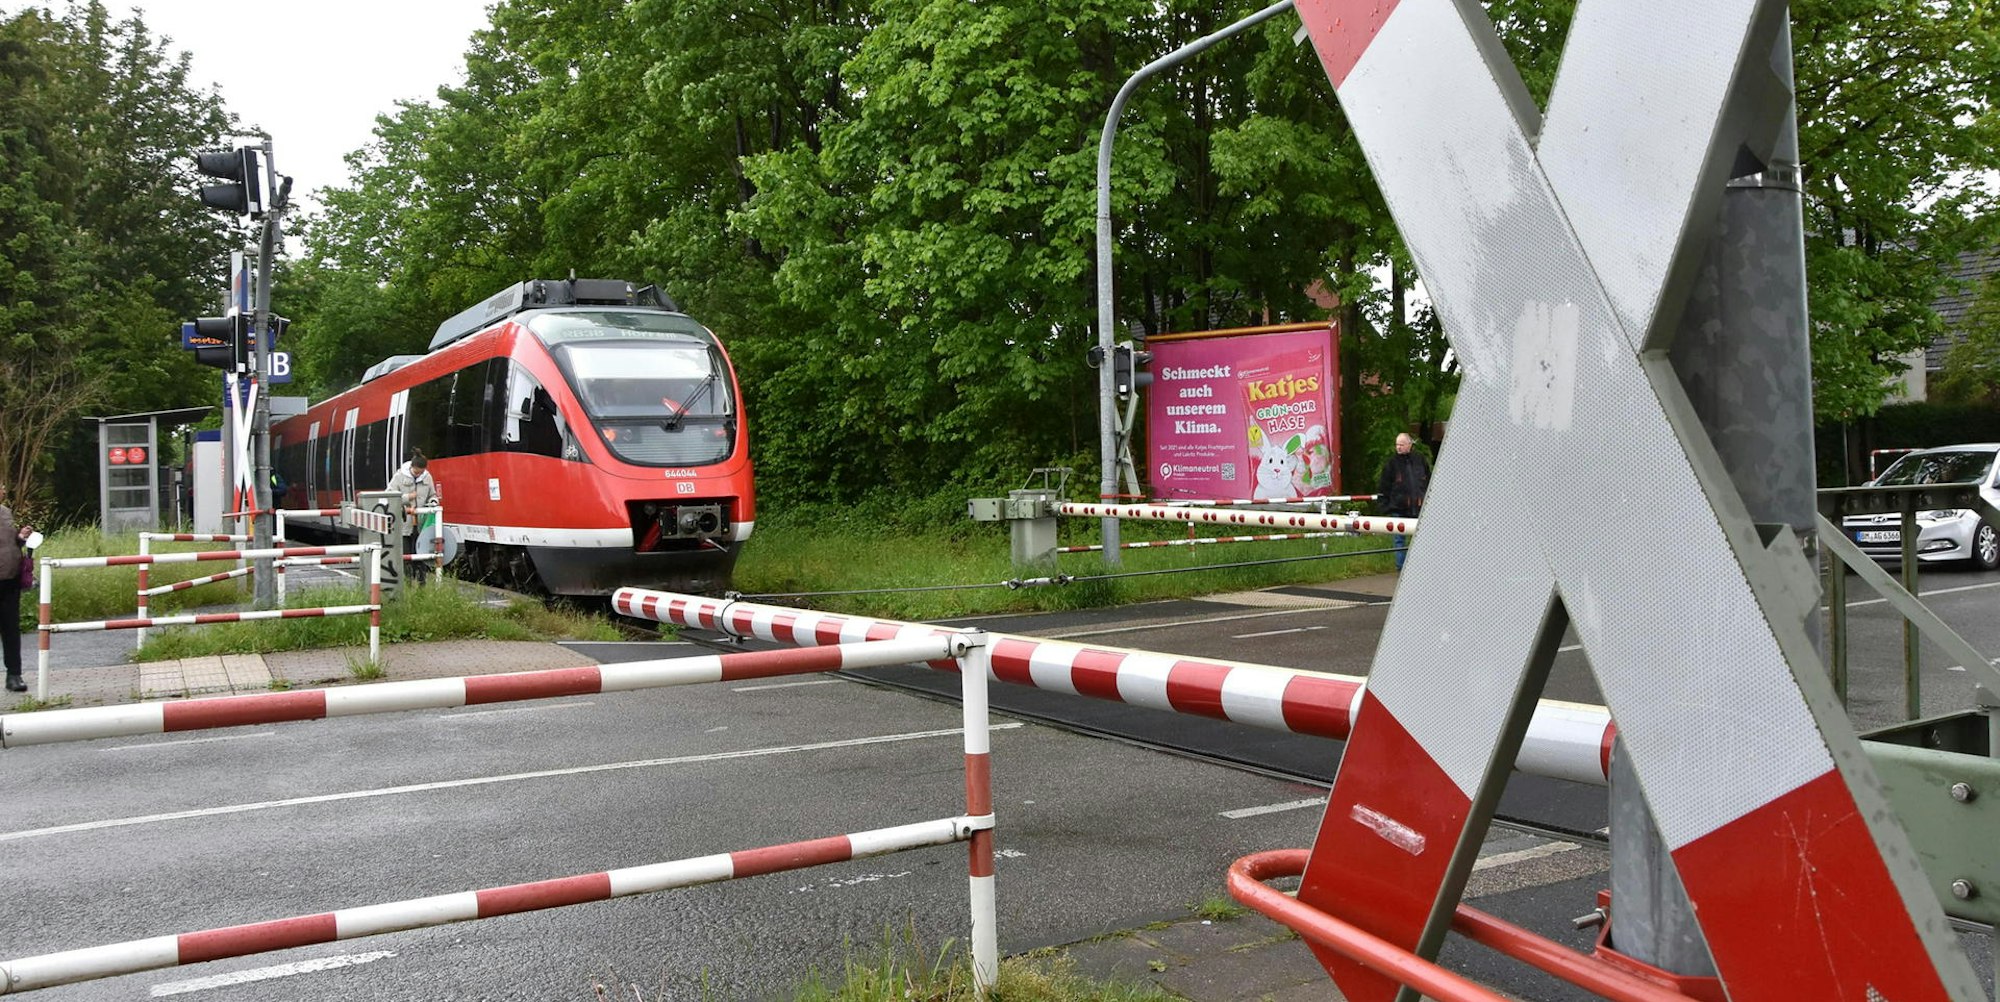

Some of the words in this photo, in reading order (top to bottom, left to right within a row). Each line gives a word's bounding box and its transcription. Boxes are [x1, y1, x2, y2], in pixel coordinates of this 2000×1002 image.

[1162, 365, 1231, 381] Schmeckt
[1179, 384, 1213, 398] auch
[1248, 374, 1319, 401] Katjes
[1166, 404, 1226, 416] unserem
[1257, 401, 1316, 419] GRÜN-OHR
[1175, 420, 1222, 434] Klima.
[1268, 416, 1304, 433] HASE
[665, 468, 697, 478] 644044
[1173, 464, 1220, 473] Klimaneutral
[678, 482, 694, 493] DB
